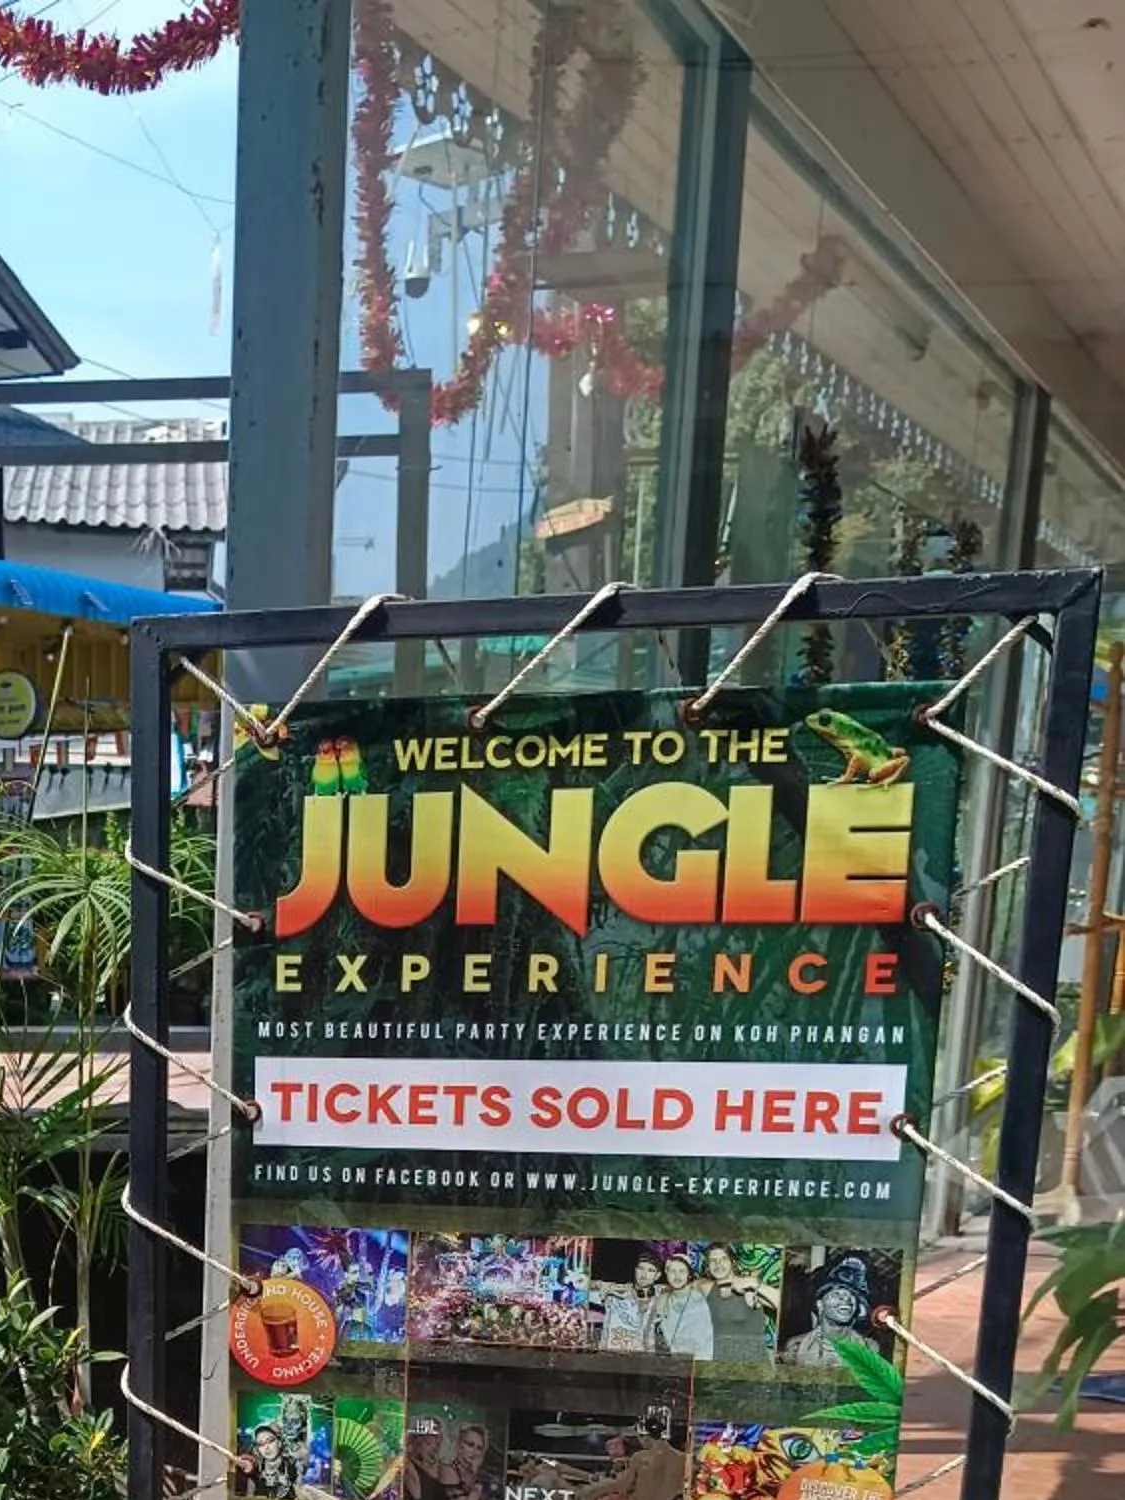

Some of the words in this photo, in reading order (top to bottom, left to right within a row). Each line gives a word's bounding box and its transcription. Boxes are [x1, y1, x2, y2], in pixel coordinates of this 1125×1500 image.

[393, 733, 607, 773] WELCOME
[623, 731, 684, 766] TO
[700, 727, 788, 764] THE
[275, 780, 914, 940] JUNGLE
[277, 952, 898, 995] EXPERIENCE
[258, 1021, 314, 1039] MOST
[325, 1022, 444, 1040] BEAUTIFUL
[455, 1022, 525, 1041] PARTY
[537, 1023, 682, 1042] EXPERIENCE
[694, 1024, 722, 1041] ON
[734, 1025, 778, 1042] KOH
[790, 1025, 905, 1045] PHANGAN
[271, 1081, 513, 1129] TICKETS
[529, 1084, 694, 1131] SOLD
[714, 1089, 883, 1137] HERE
[254, 1164, 298, 1181] FIND
[308, 1166, 332, 1181] US
[342, 1167, 366, 1184] ON
[375, 1167, 479, 1187] FACEBOOK
[490, 1171, 514, 1188] OR
[526, 1172, 891, 1200] WWW.JUNGLE-EXPERIENCE.COM
[291, 1287, 328, 1328] HOUSE
[272, 1347, 325, 1379] TECHNO
